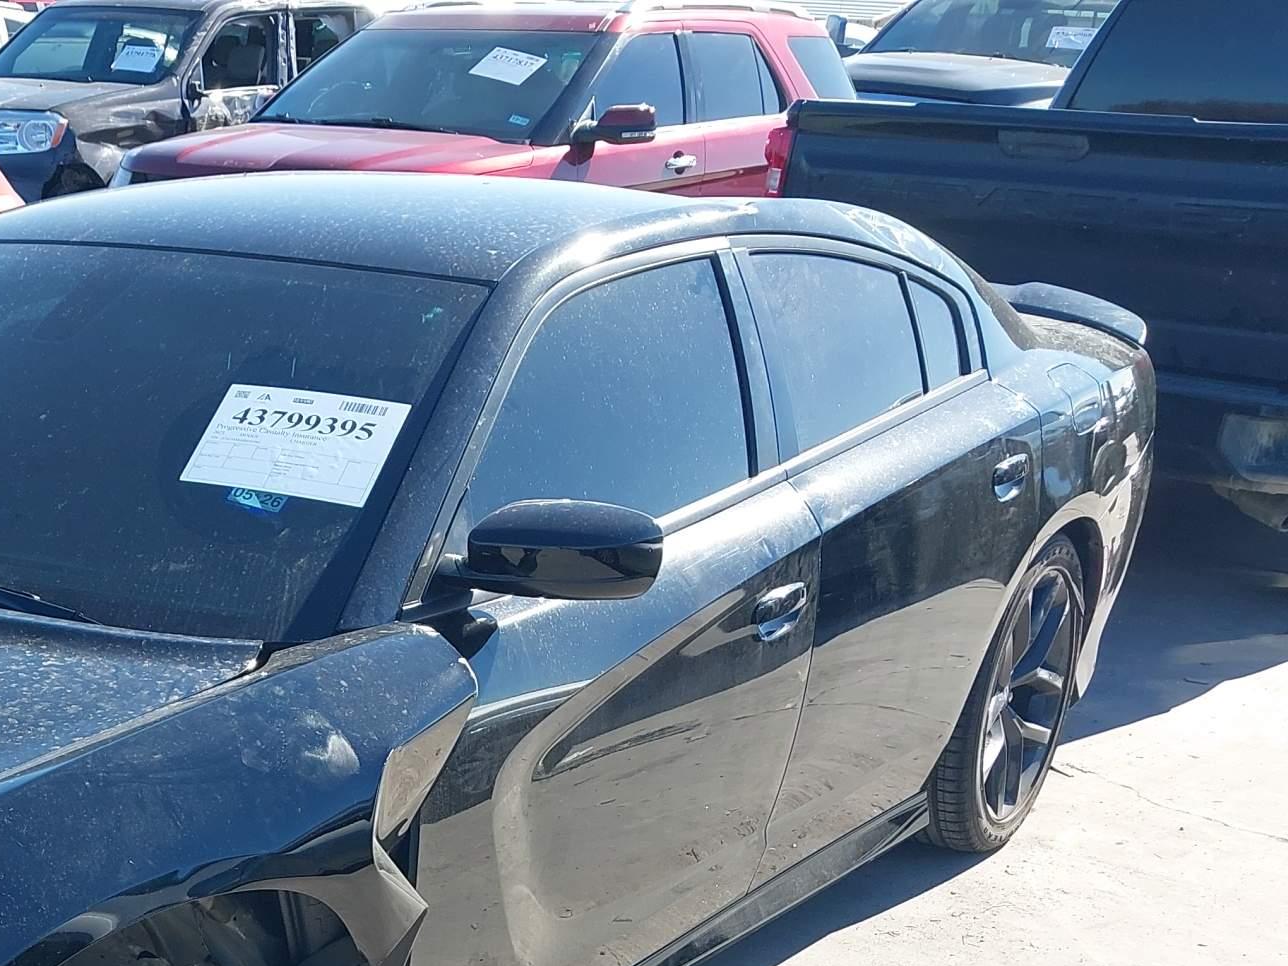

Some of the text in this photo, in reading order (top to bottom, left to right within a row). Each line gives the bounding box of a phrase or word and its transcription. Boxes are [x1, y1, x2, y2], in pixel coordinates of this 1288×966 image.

[216, 423, 328, 442] Progressive Casualty Insurance
[232, 407, 377, 440] 43799395
[233, 488, 283, 508] 05 26
